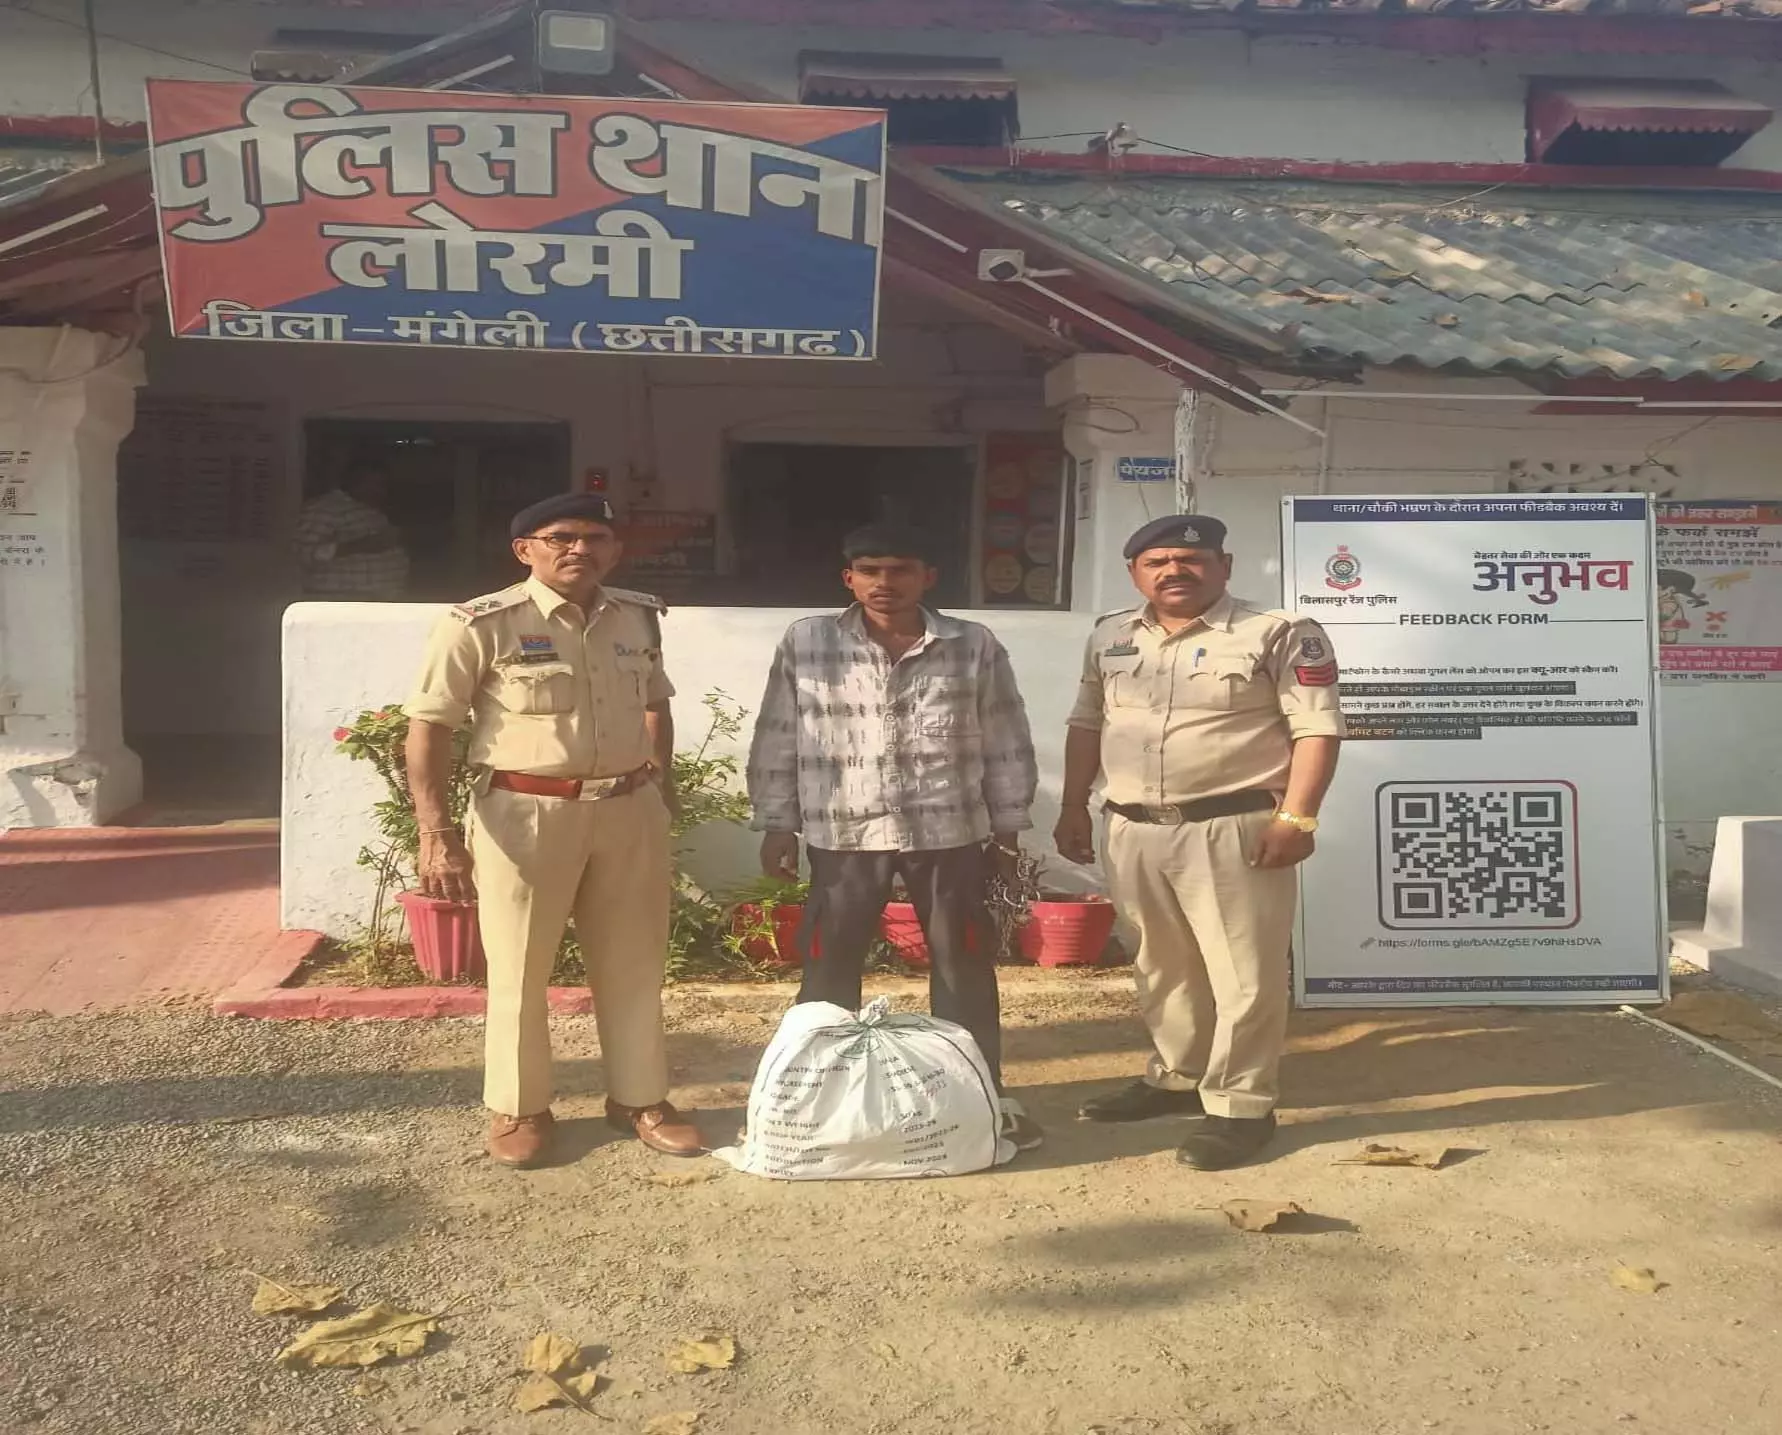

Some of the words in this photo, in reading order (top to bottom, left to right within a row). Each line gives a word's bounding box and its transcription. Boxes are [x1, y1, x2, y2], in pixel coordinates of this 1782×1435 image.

[155, 85, 568, 242] पुलिस
[322, 202, 694, 300] लोरमी
[201, 300, 348, 341] जिला
[1433, 502, 1445, 512] के
[1483, 503, 1517, 512] अपना
[1569, 502, 1607, 512] अवश्य
[1300, 594, 1348, 607] बिलासपुर
[1366, 594, 1397, 607] पुलिस
[1473, 561, 1634, 605] अनुभव
[1399, 613, 1493, 625] FEEDBACK
[1498, 613, 1548, 625] FORM
